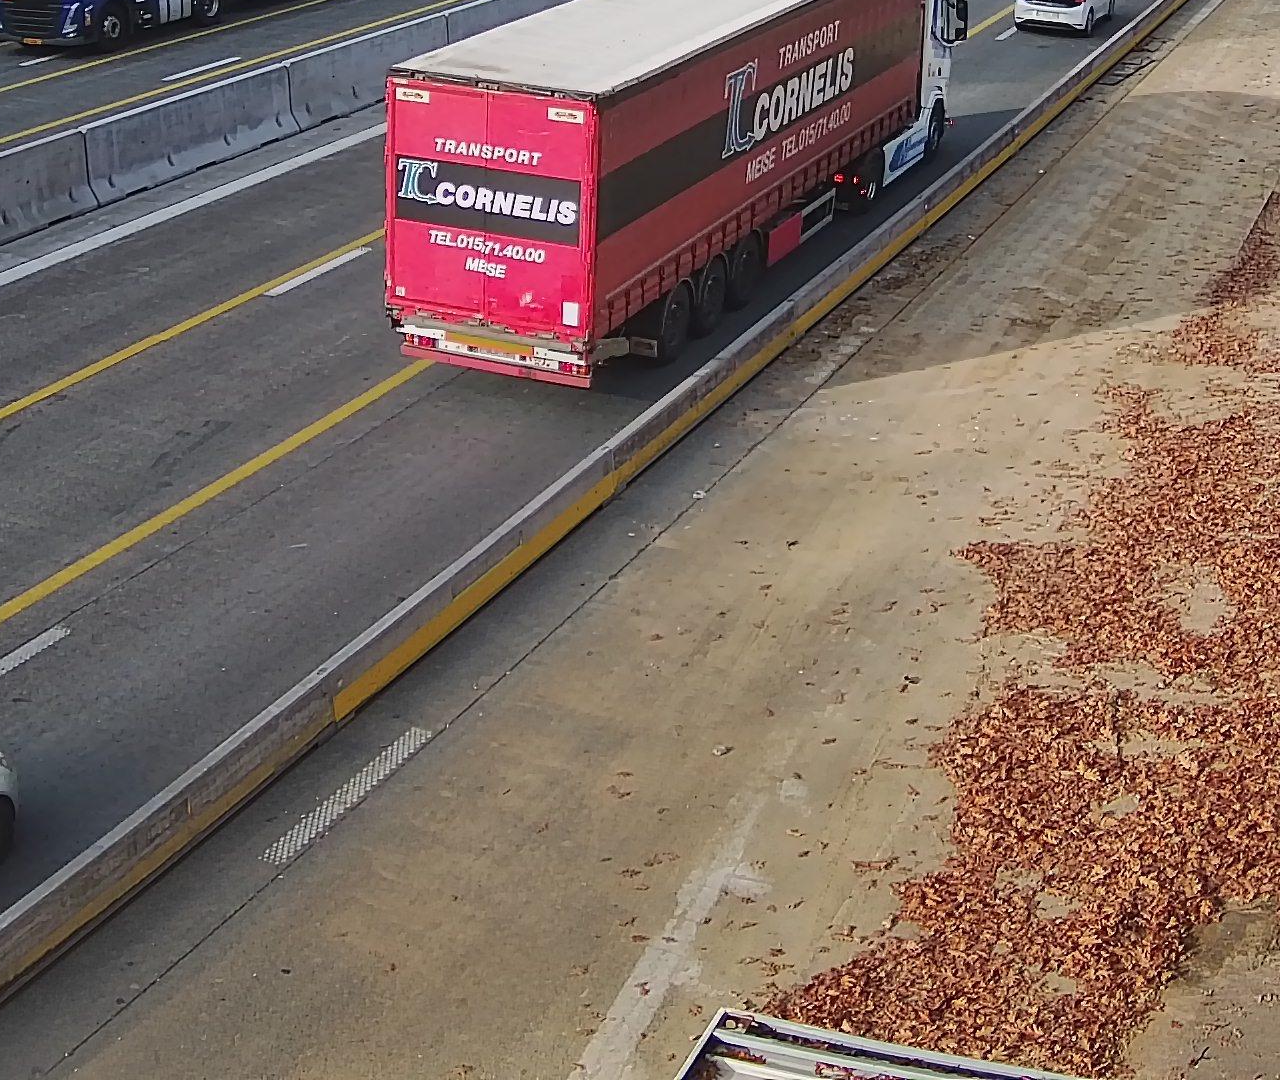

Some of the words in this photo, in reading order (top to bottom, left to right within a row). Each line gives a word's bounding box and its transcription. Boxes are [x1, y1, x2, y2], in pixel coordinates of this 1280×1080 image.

[778, 20, 841, 69] TRANSPORT
[753, 47, 854, 141] CORNELIS
[434, 138, 542, 166] TRANSPORT
[435, 182, 578, 226] CORNELIS
